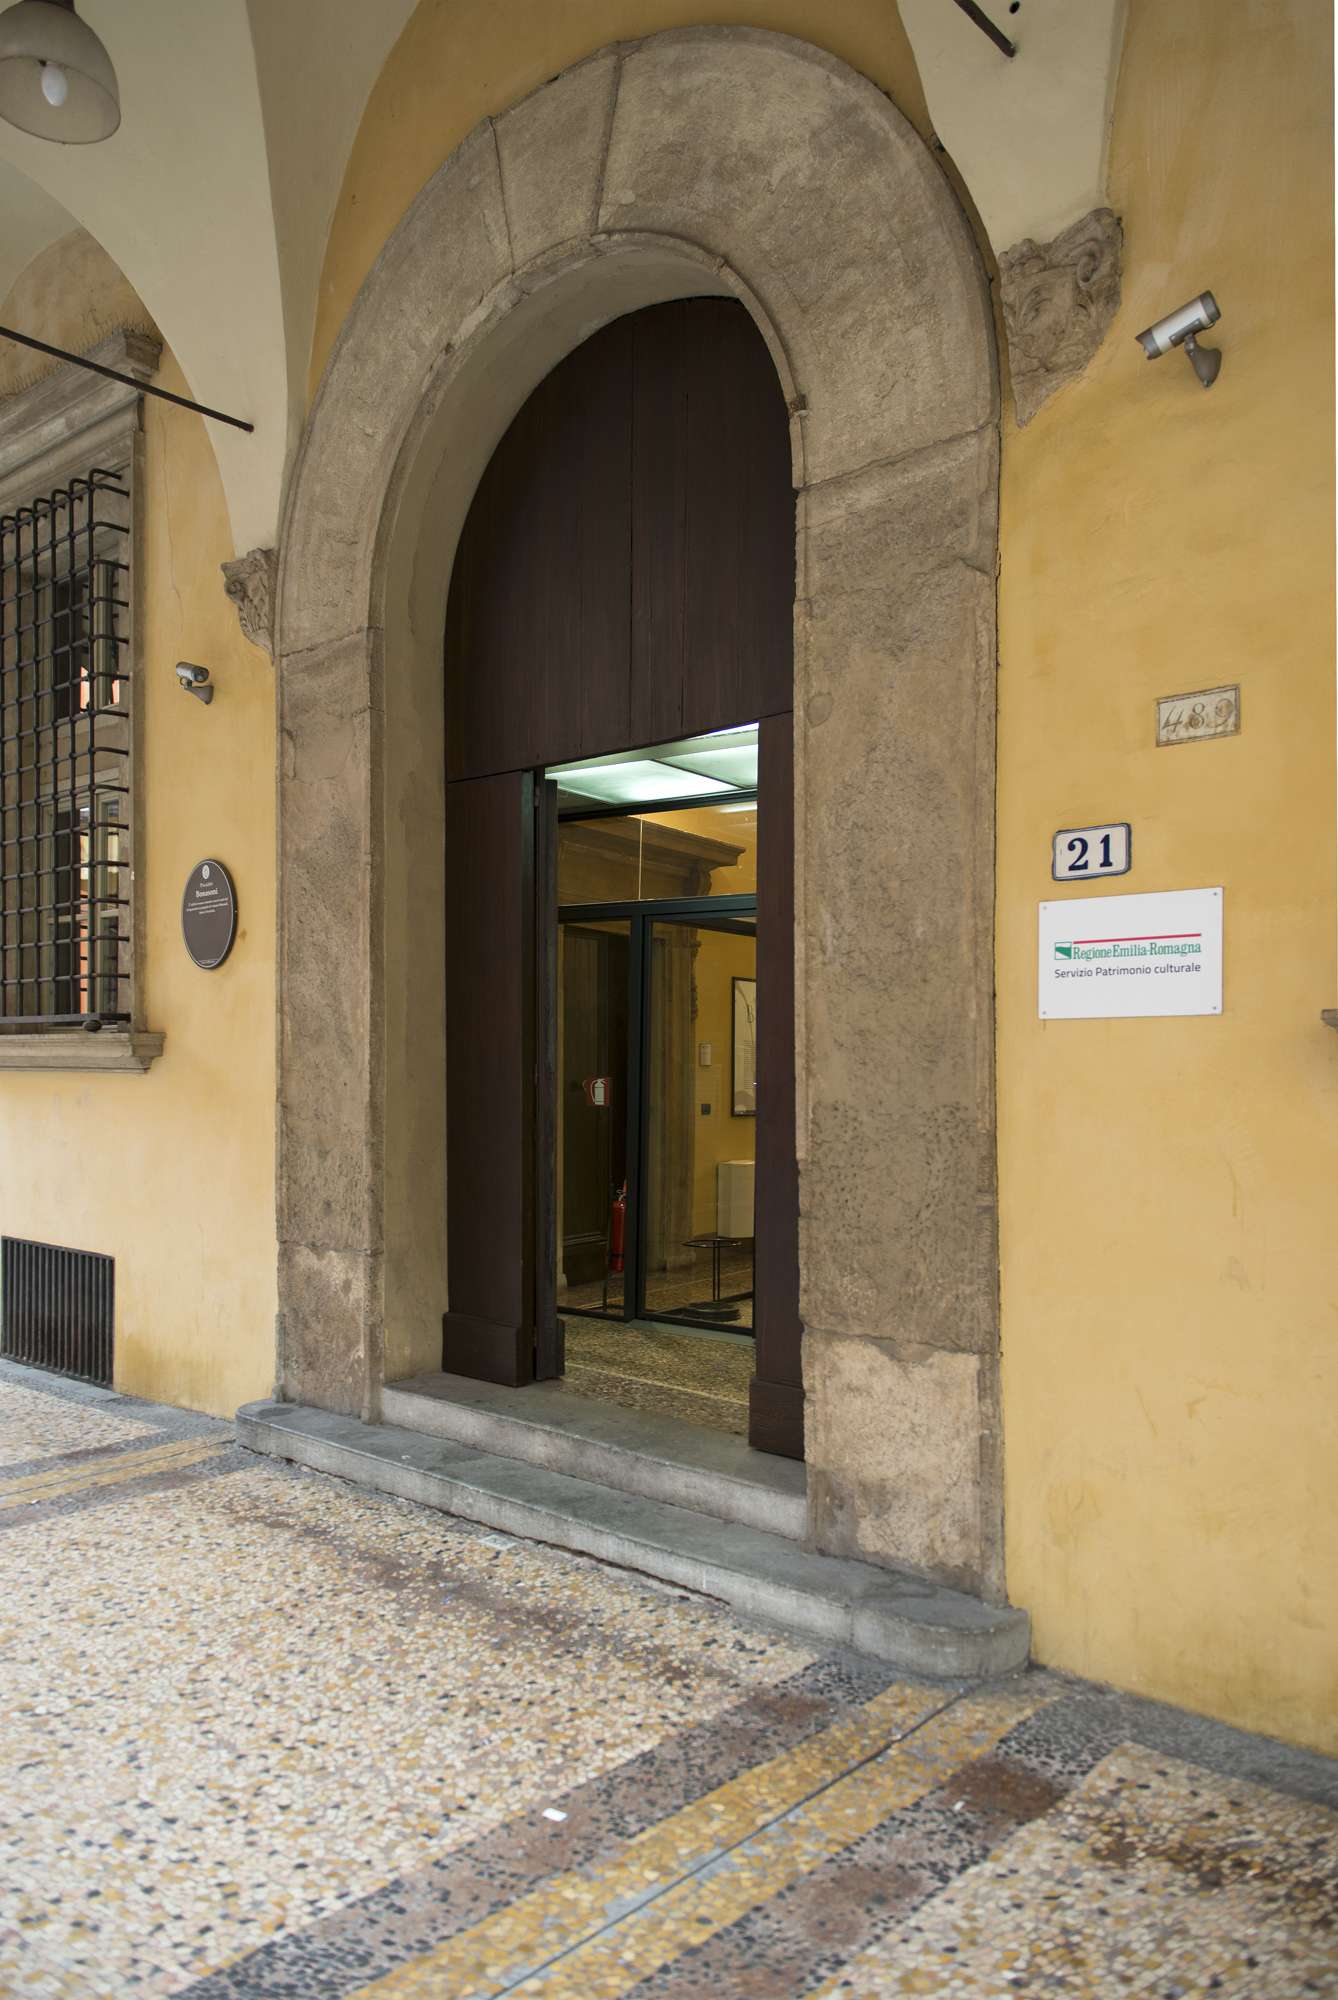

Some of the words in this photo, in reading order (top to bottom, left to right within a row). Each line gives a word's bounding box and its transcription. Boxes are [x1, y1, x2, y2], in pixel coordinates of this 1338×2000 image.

[1067, 834, 1113, 872] 21
[1054, 968, 1093, 979] Servizio
[1095, 964, 1152, 976] Patrimonio
[1154, 962, 1201, 974] culturale
